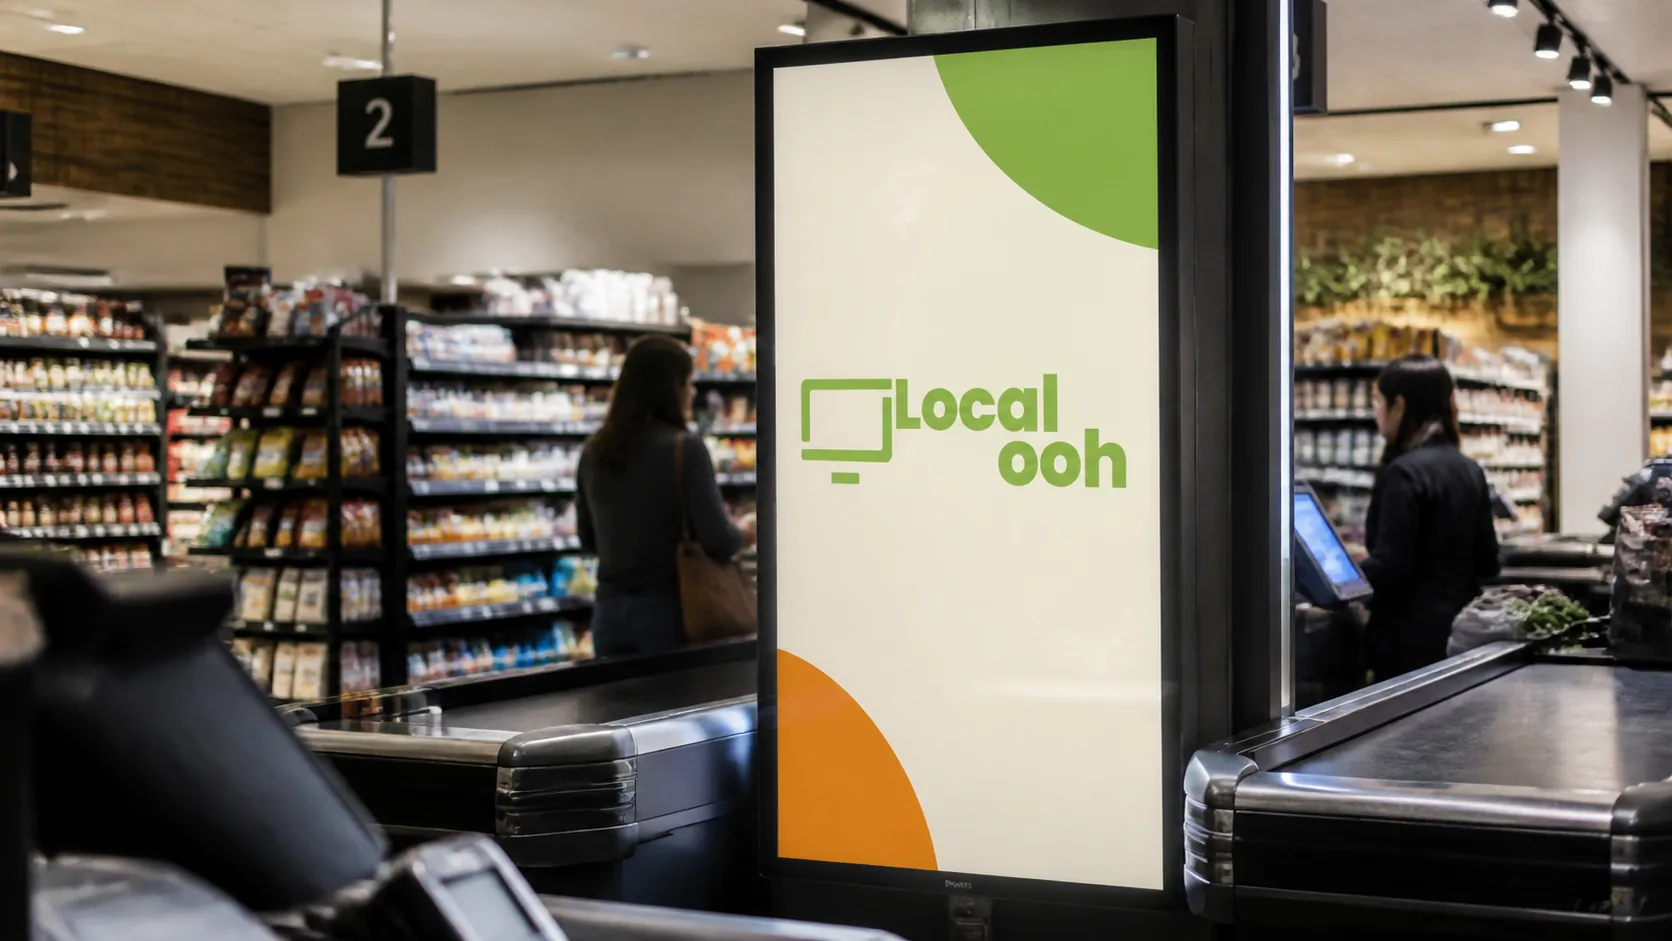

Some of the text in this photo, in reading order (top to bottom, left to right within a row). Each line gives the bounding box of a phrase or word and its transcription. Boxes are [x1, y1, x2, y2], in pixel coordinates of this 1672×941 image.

[364, 98, 394, 148] 2
[896, 373, 1059, 433] Local
[998, 428, 1127, 489] ooh
